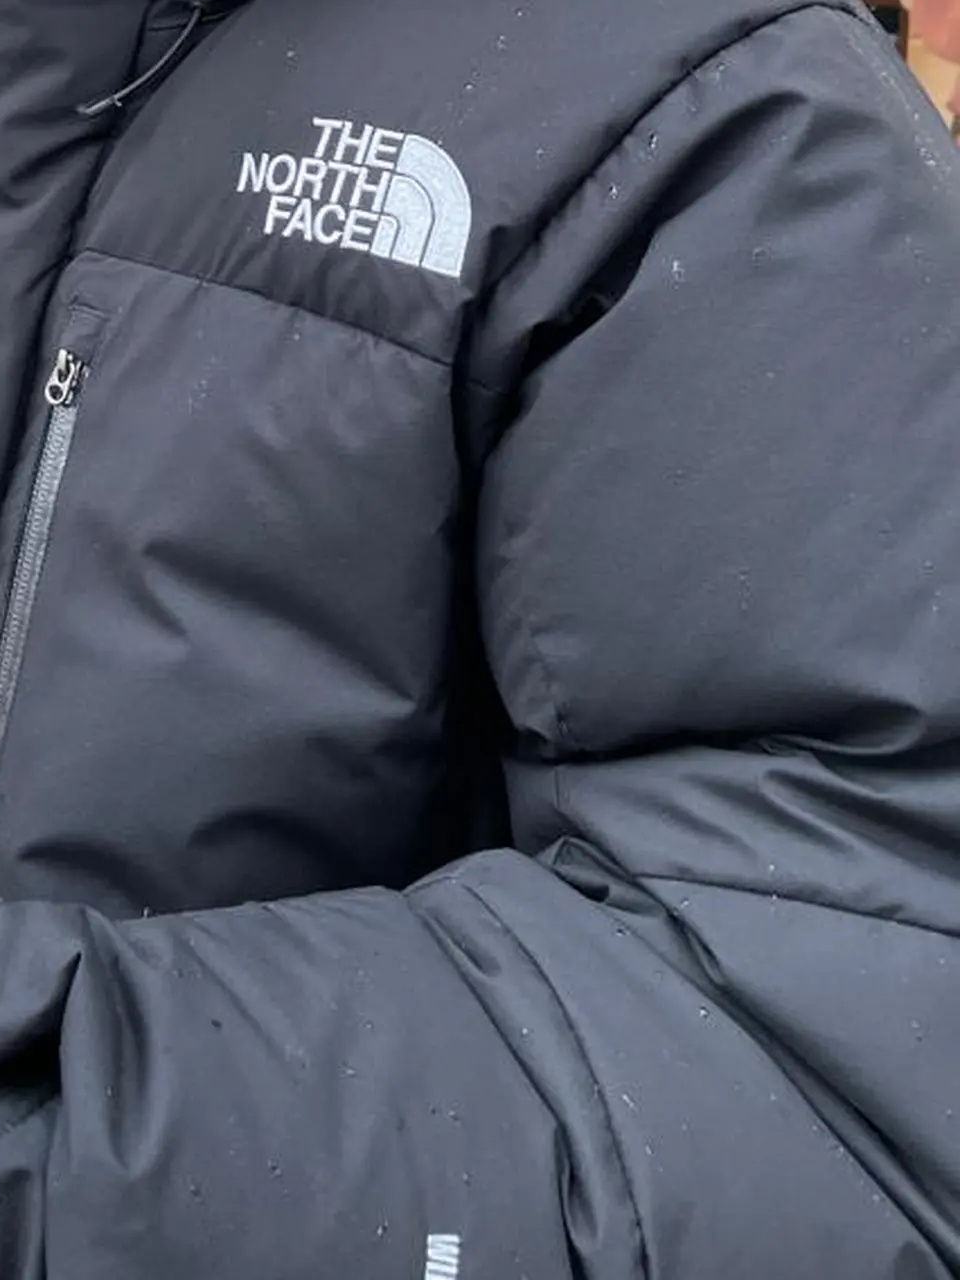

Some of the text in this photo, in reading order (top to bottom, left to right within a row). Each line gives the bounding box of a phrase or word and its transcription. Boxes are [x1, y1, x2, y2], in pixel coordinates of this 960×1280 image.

[312, 116, 405, 170] THE
[236, 153, 391, 213] NORTH
[263, 195, 381, 251] FACE
